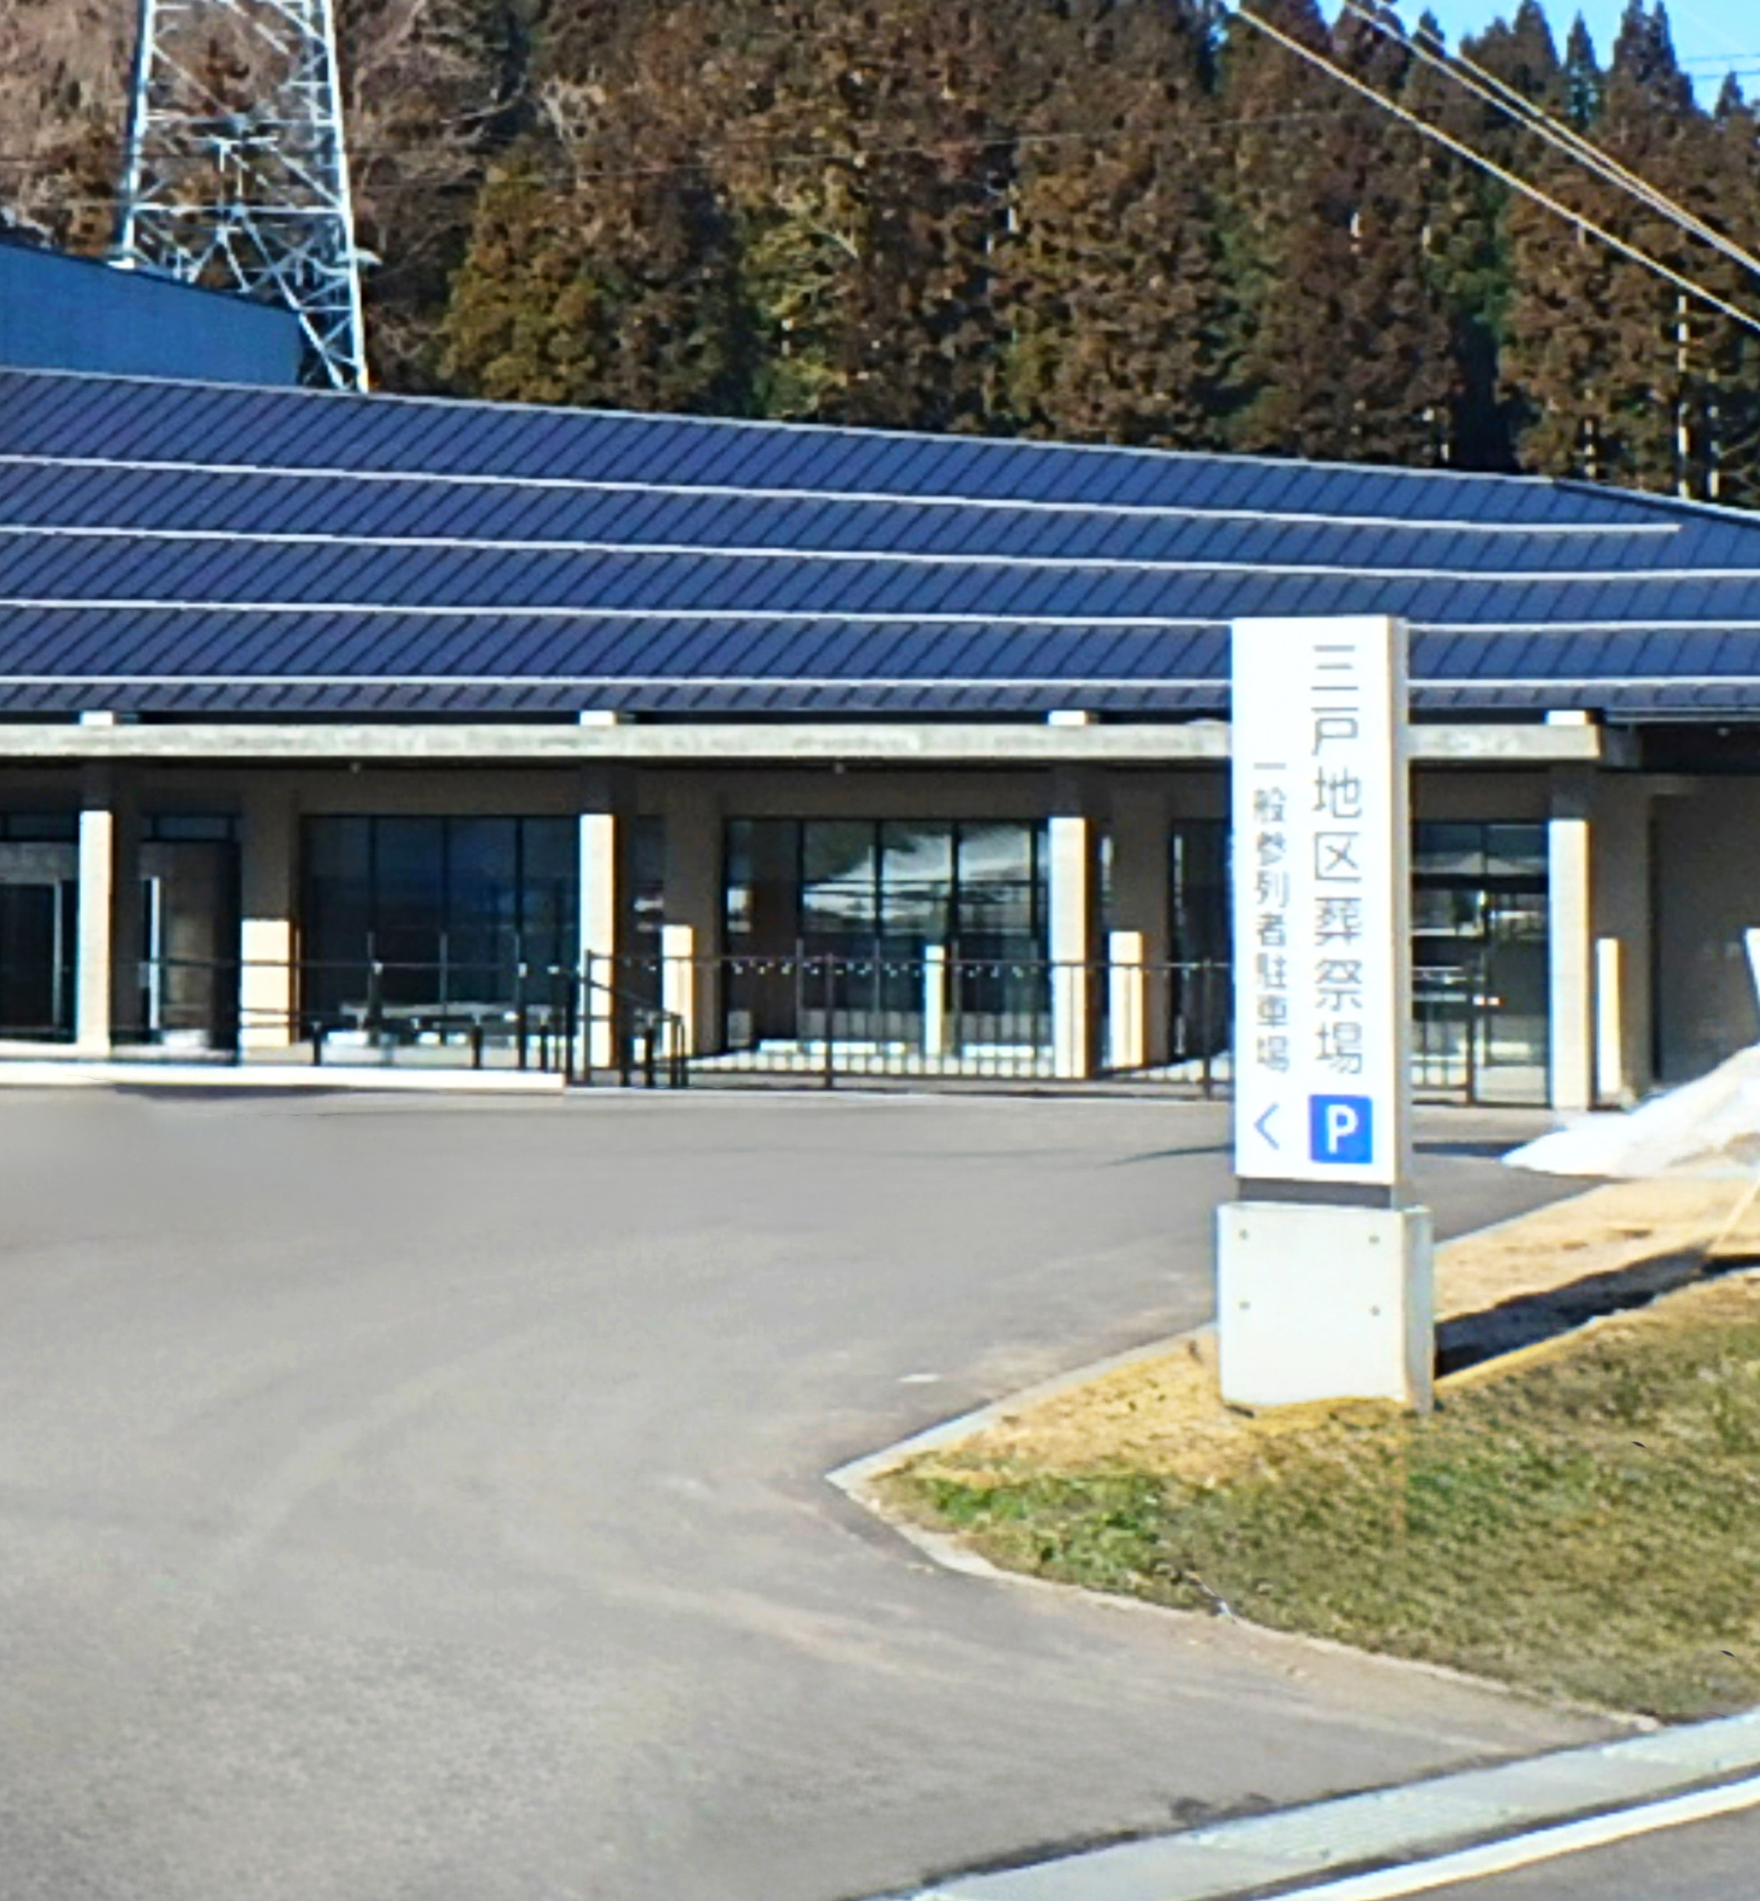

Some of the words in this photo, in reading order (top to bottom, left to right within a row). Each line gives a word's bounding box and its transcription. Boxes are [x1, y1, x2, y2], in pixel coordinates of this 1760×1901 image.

[1312, 645, 1362, 1074] 三戸地区葬祭場
[1327, 1104, 1358, 1154] P
